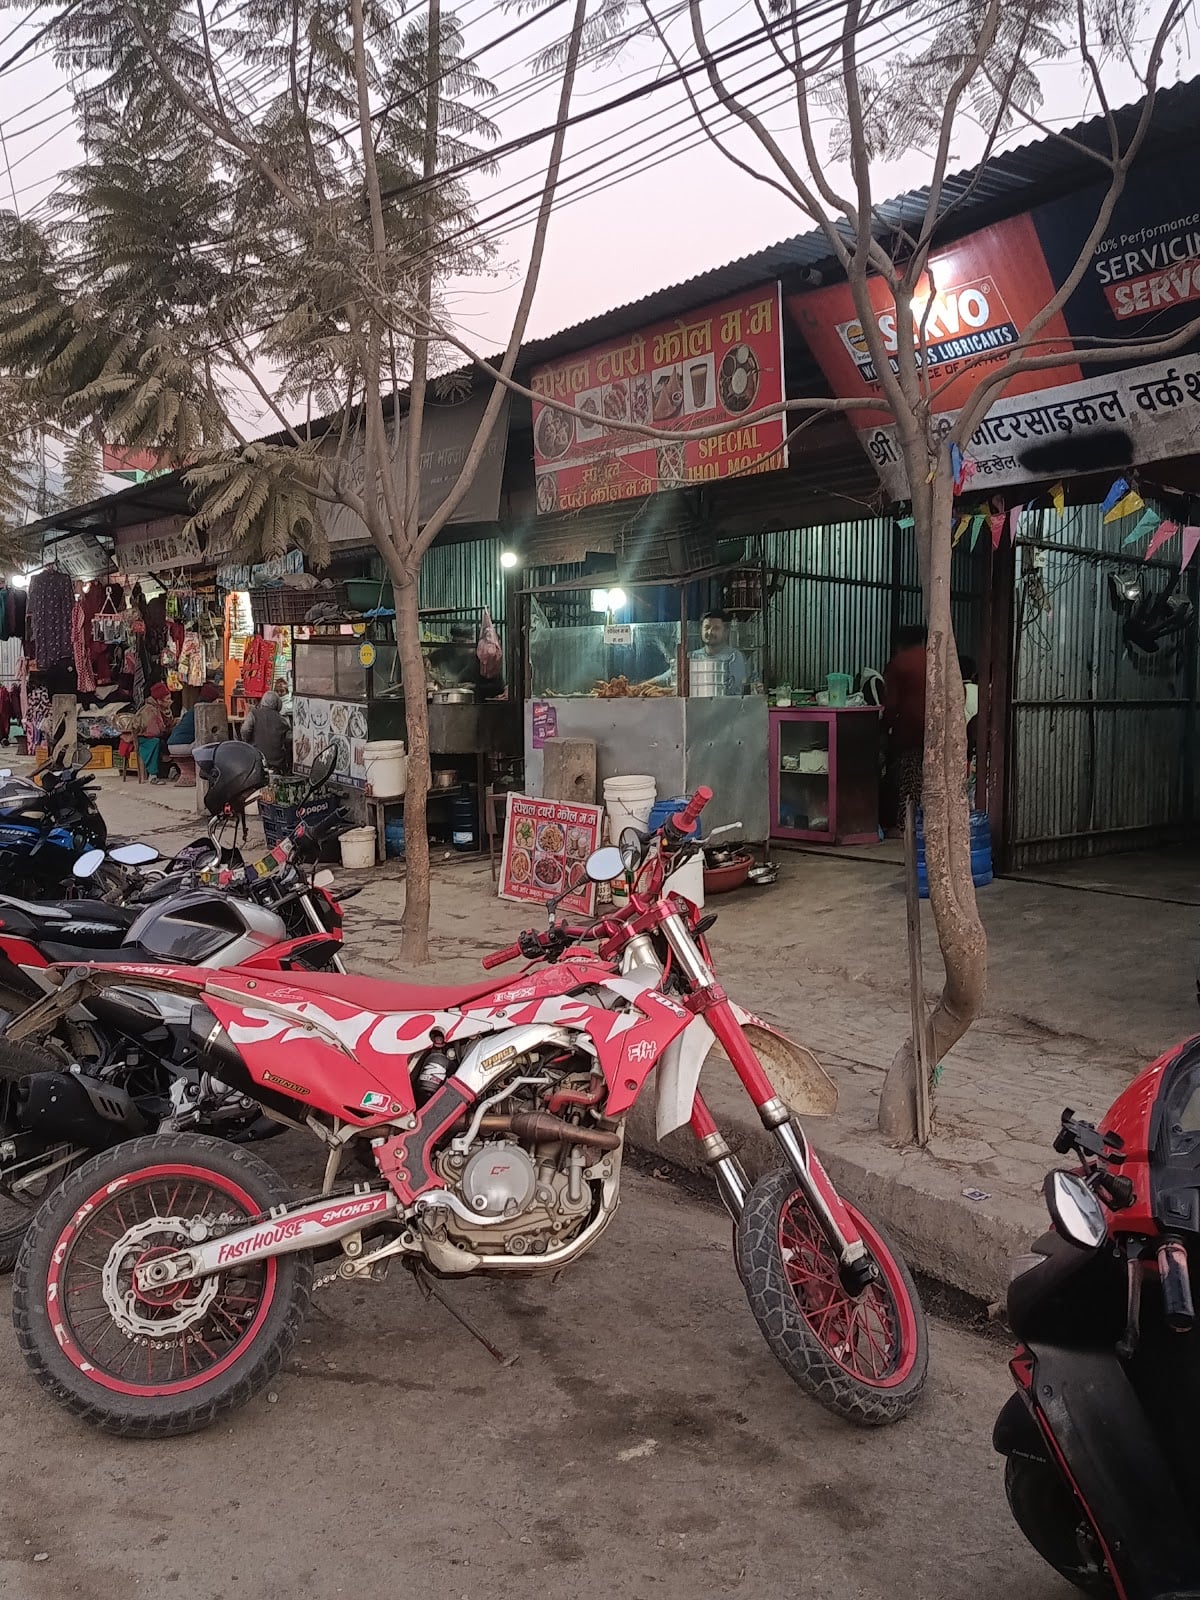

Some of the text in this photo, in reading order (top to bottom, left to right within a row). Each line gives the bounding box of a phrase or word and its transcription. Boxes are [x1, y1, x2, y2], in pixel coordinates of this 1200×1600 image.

[1120, 213, 1199, 246] Performance
[878, 288, 990, 351] SRVO
[596, 335, 646, 383] टपरी
[653, 318, 713, 365] झोल
[938, 326, 1013, 359] LUBRICANTS
[945, 362, 960, 375] OF
[699, 426, 762, 459] SPECIAL
[869, 430, 898, 466] श्री
[306, 802, 329, 815] pepsi
[269, 1075, 311, 1096] DUNLOP
[218, 1197, 384, 1264] FASTHOUSE SMOKEY
